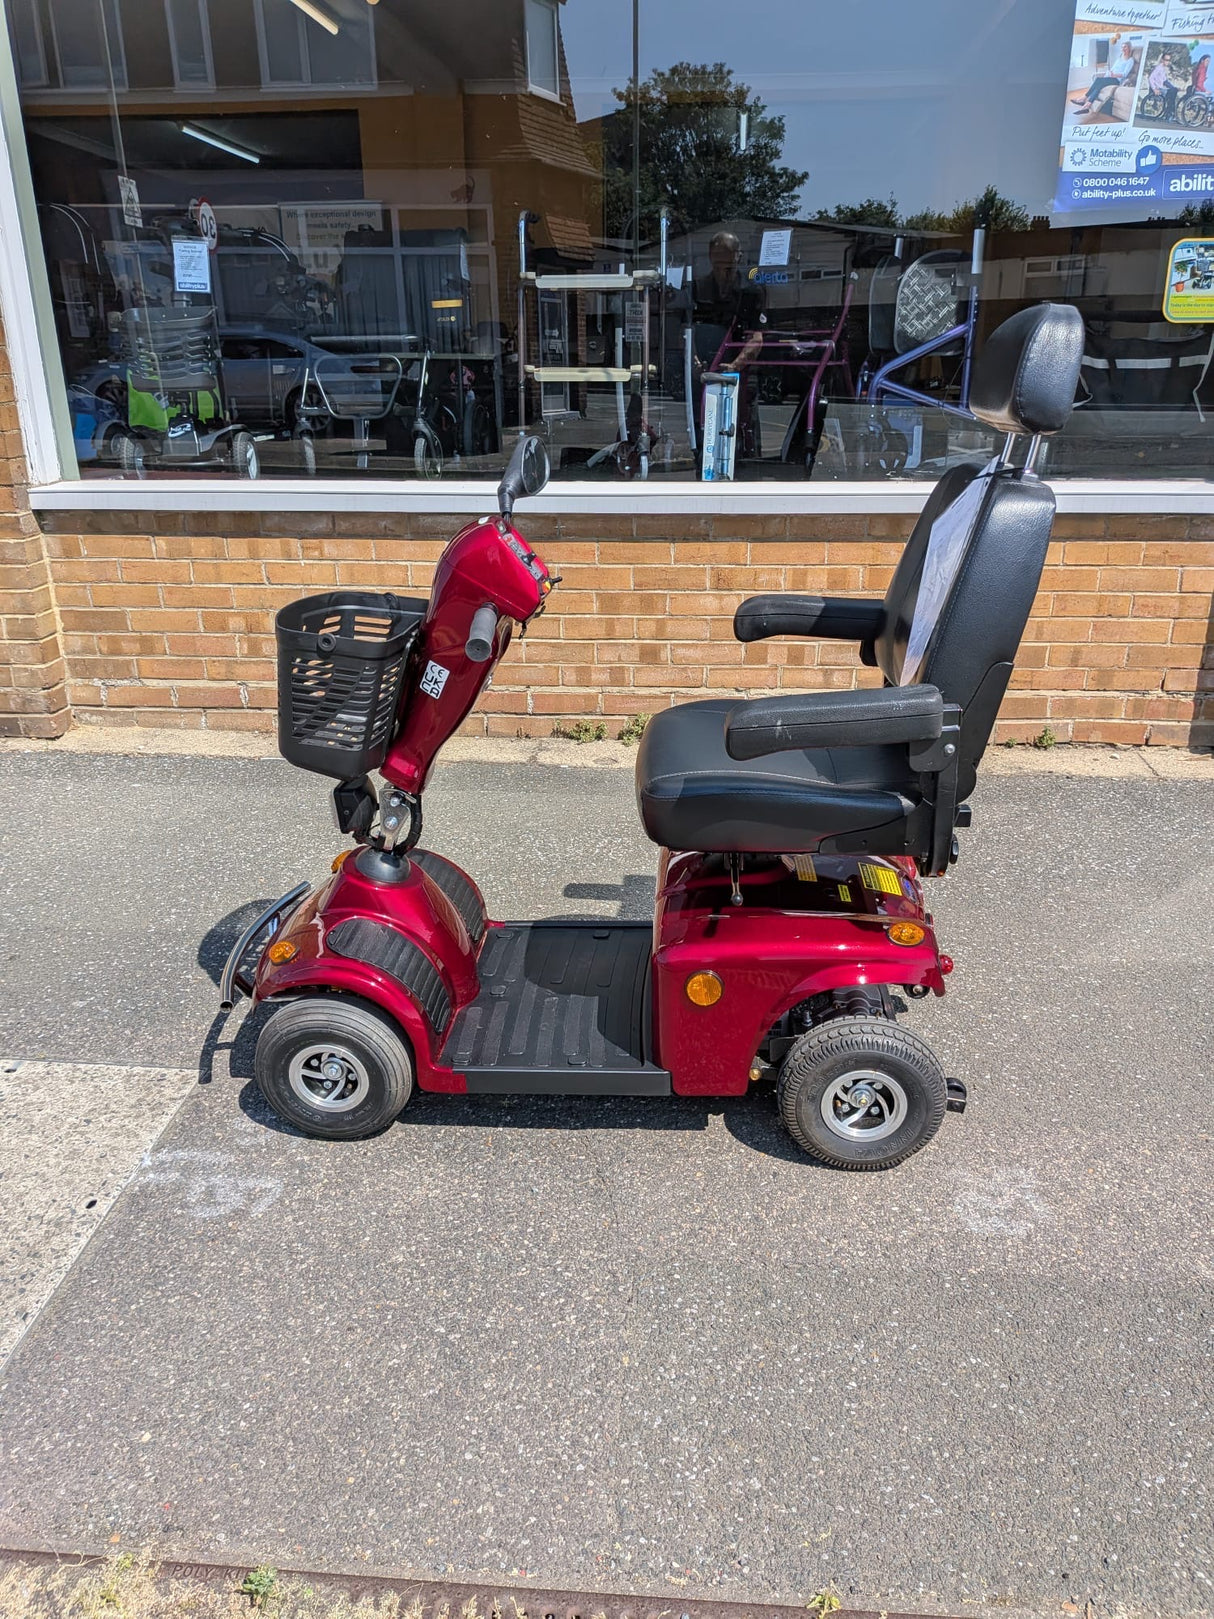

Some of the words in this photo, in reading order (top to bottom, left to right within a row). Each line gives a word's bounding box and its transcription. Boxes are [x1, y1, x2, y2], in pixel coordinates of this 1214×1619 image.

[1085, 3, 1126, 17] Adventure
[1172, 13, 1205, 32] Fishing
[1072, 126, 1091, 137] Put
[1089, 126, 1111, 142] feet
[1110, 127, 1127, 141] up!
[1138, 130, 1151, 145] Go
[1151, 135, 1172, 146] more
[1089, 148, 1133, 161] Motability
[1089, 157, 1122, 167] Scheme
[1082, 178, 1108, 187] 0800
[1108, 177, 1128, 187] 046
[1128, 176, 1149, 187] 1647
[1082, 187, 1156, 200] ability-plus.co.uk
[430, 664, 445, 678] CE
[425, 672, 443, 690] UK
[171, 1564, 214, 1579] POLY
